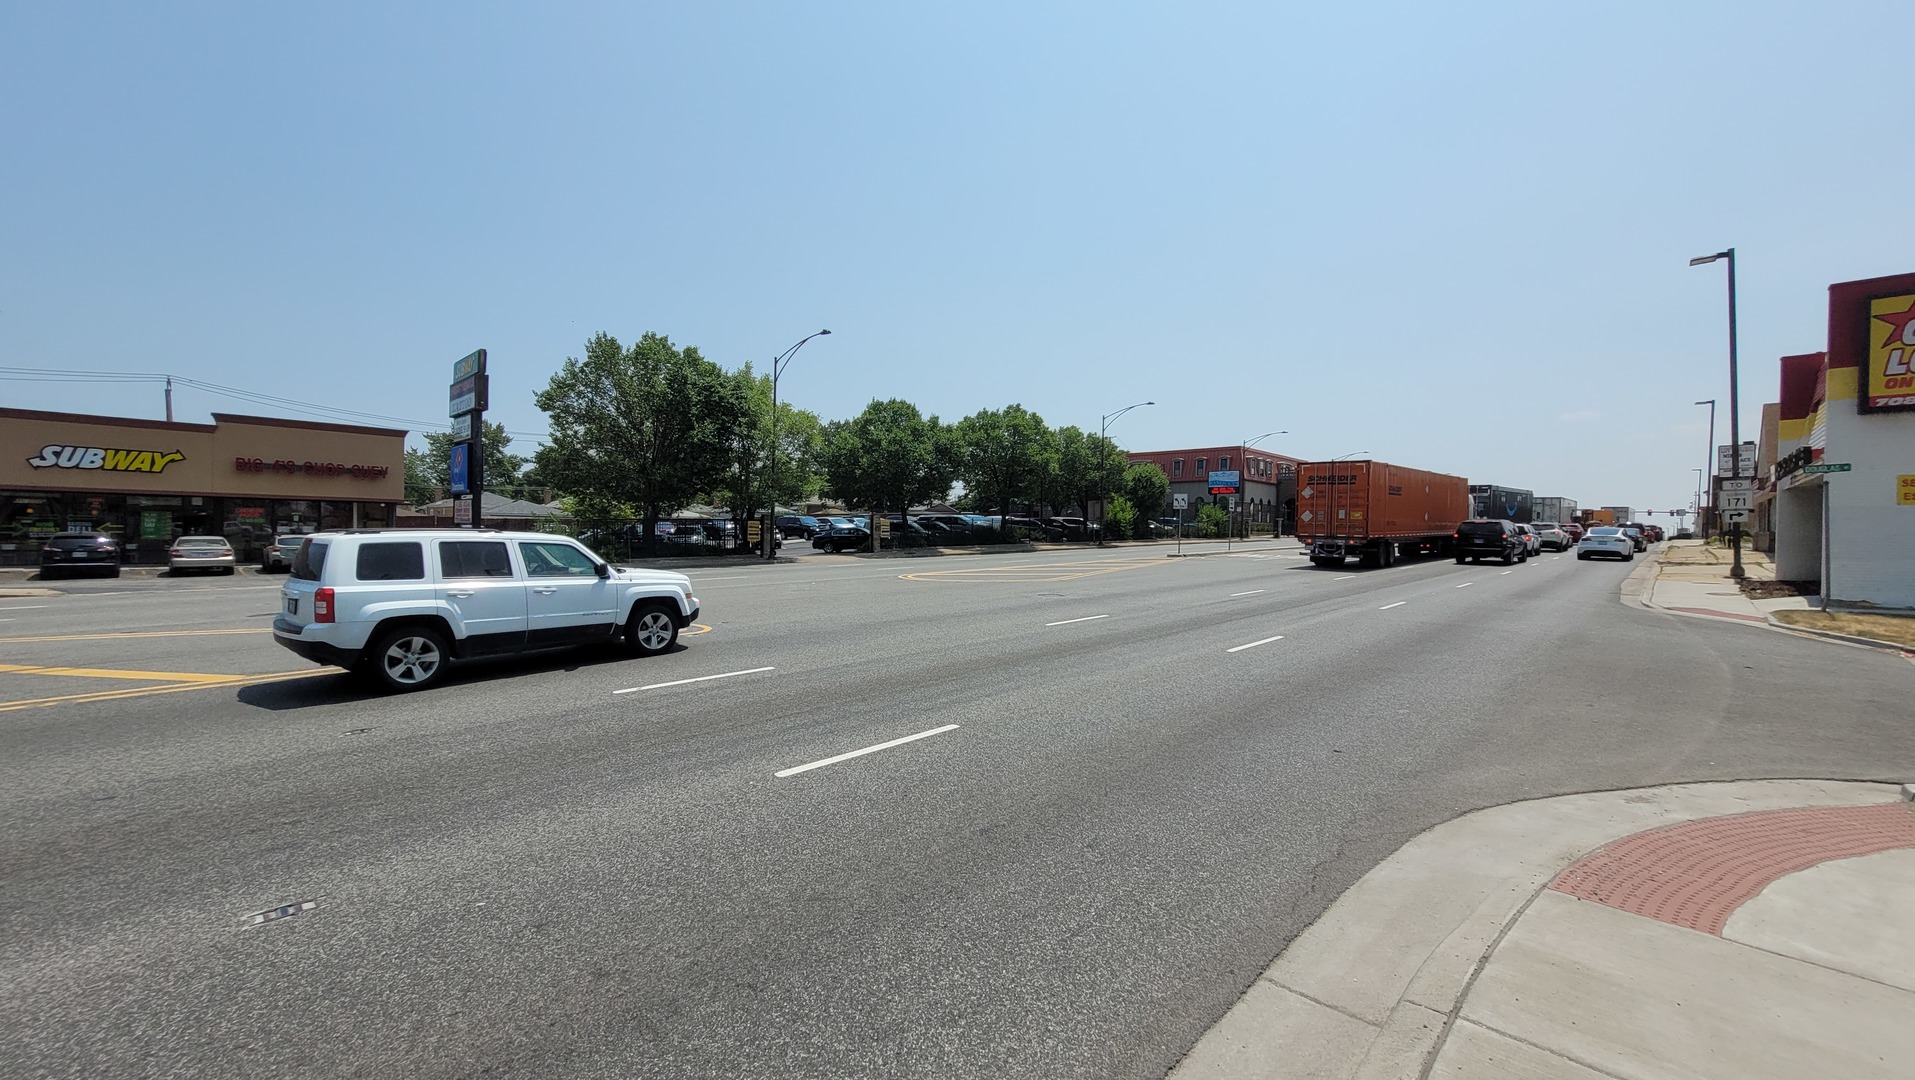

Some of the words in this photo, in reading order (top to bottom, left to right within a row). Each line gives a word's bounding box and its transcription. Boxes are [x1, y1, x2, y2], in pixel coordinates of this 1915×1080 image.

[26, 444, 186, 473] SUBWAY
[235, 457, 264, 473] BIG
[303, 461, 346, 477] CHOP
[351, 464, 389, 480] SUEY
[1805, 465, 1840, 473] DOUGLAS
[1727, 497, 1746, 507] 171
